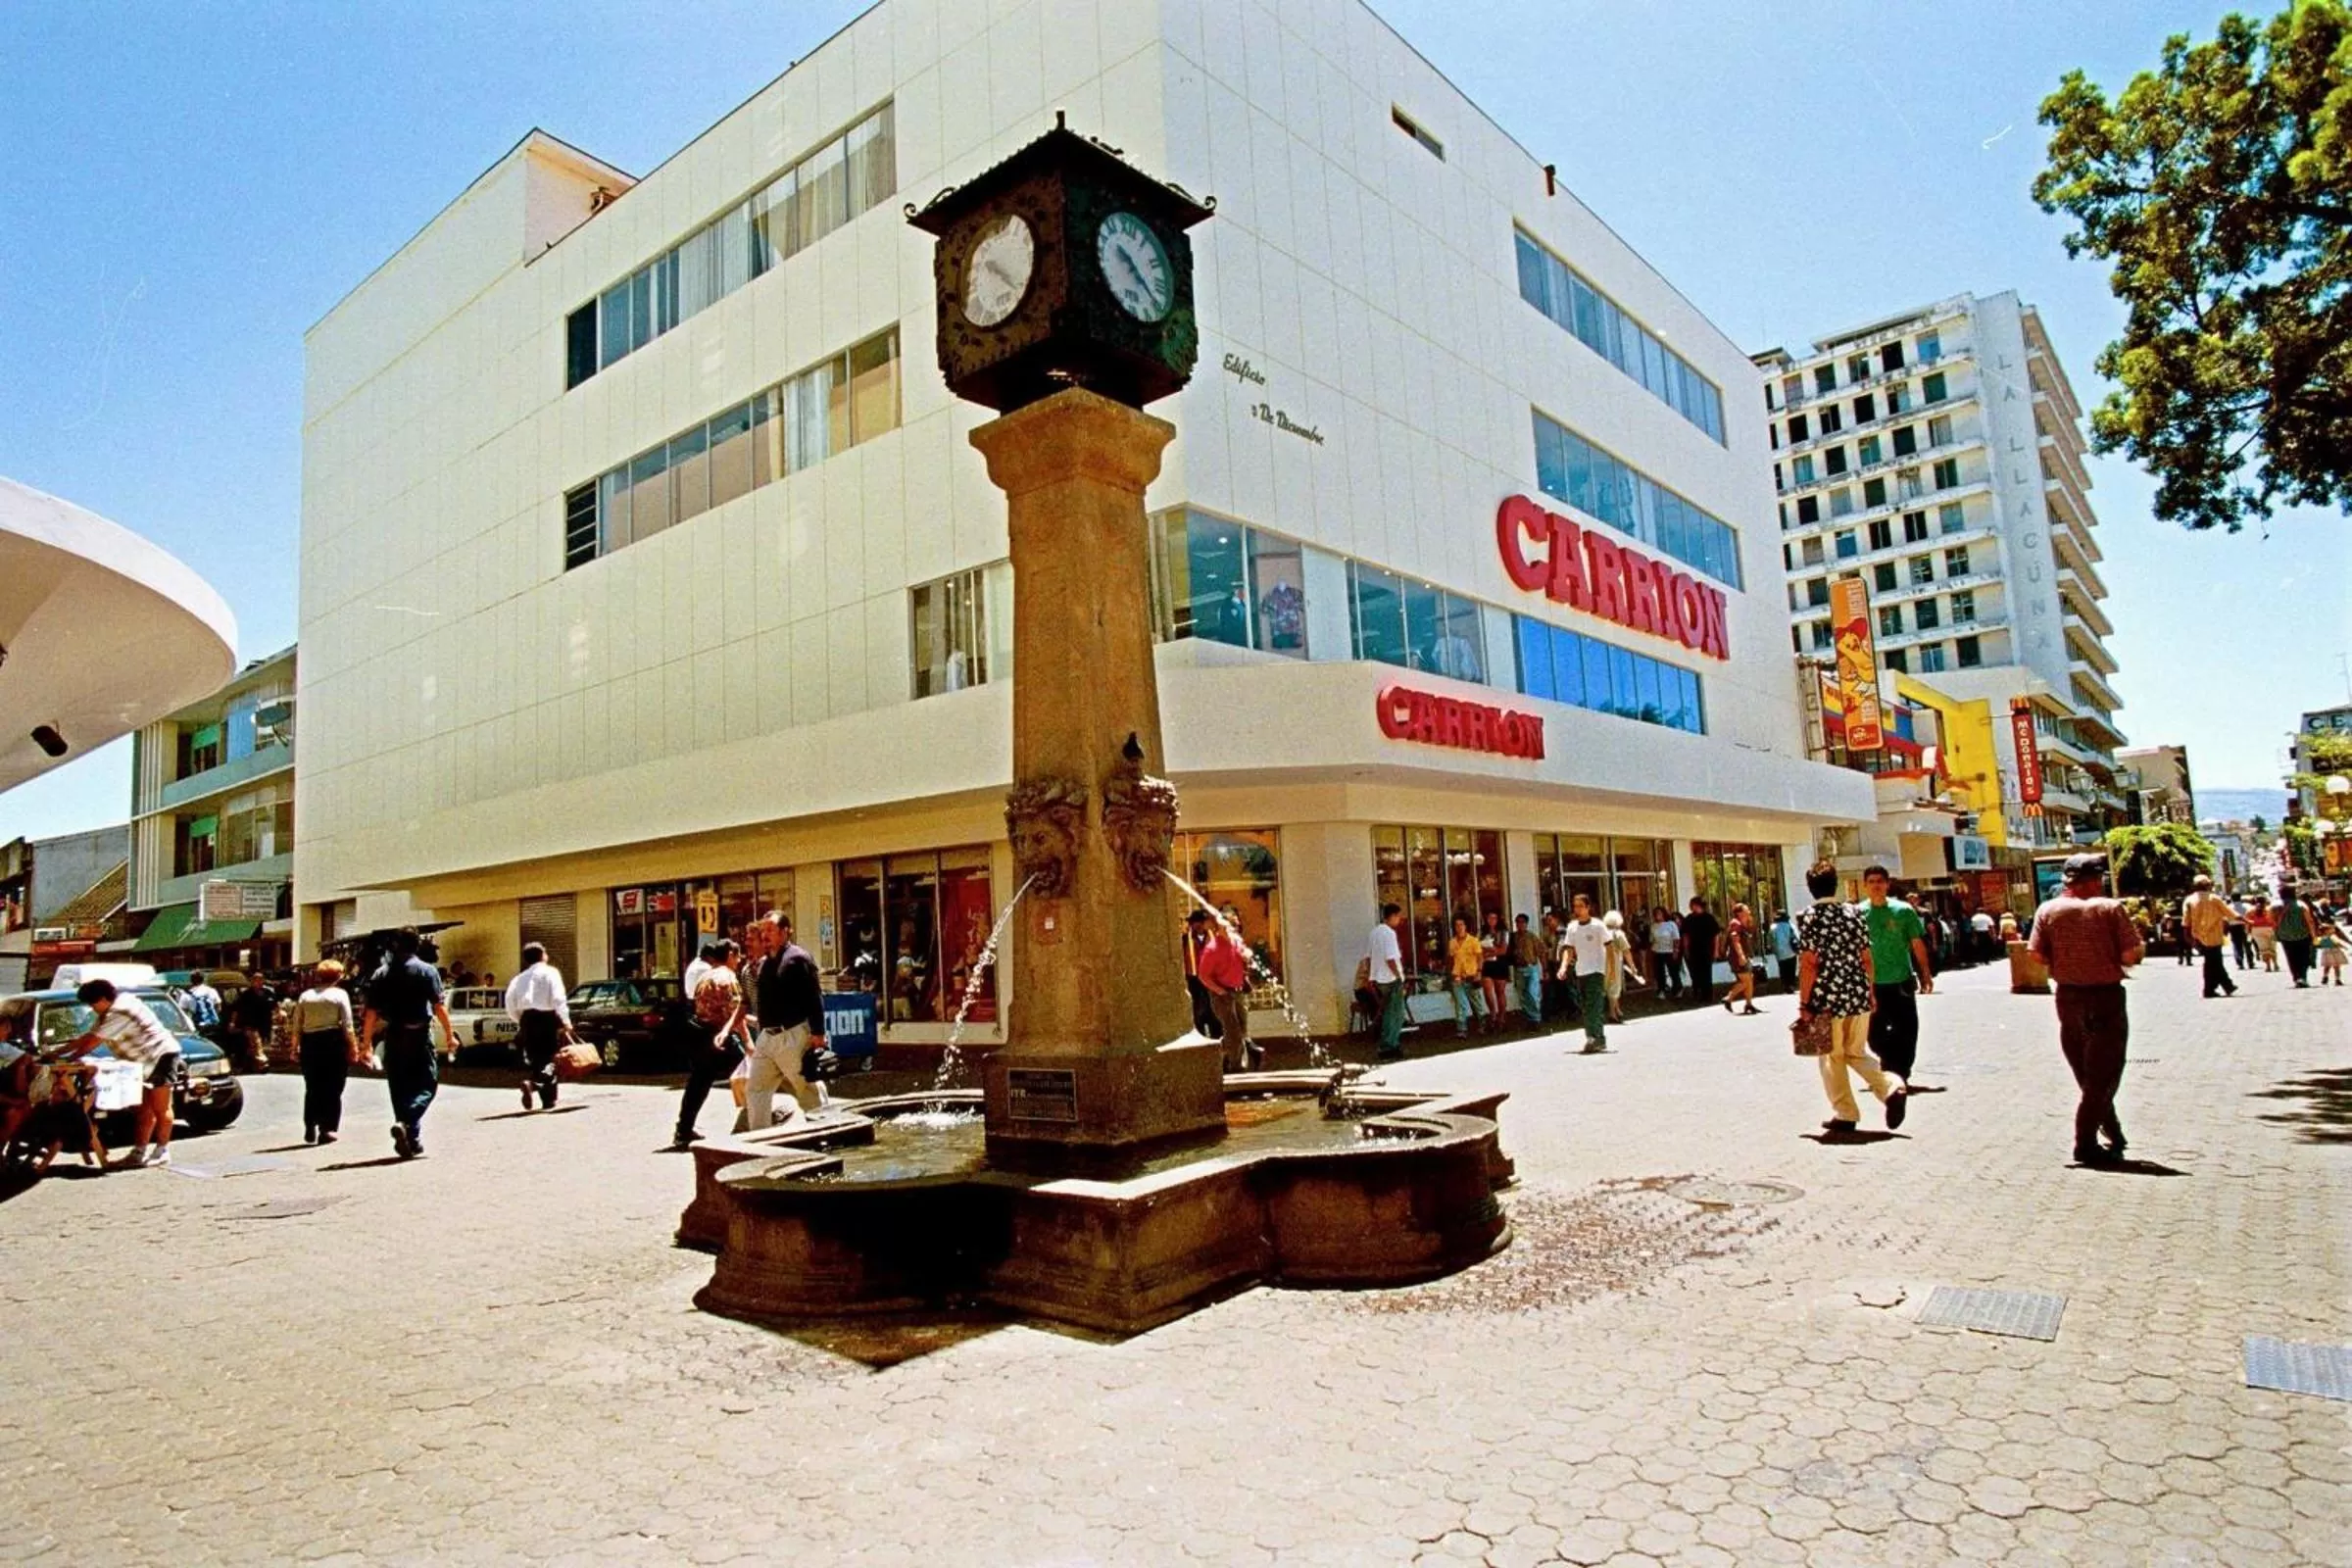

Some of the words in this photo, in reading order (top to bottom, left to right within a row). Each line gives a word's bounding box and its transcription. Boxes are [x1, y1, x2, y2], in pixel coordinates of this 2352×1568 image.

[1496, 495, 1729, 660] CARRION
[1376, 686, 1545, 760] CARRION
[2308, 713, 2349, 731] CE
[496, 1022, 519, 1033] NIS
